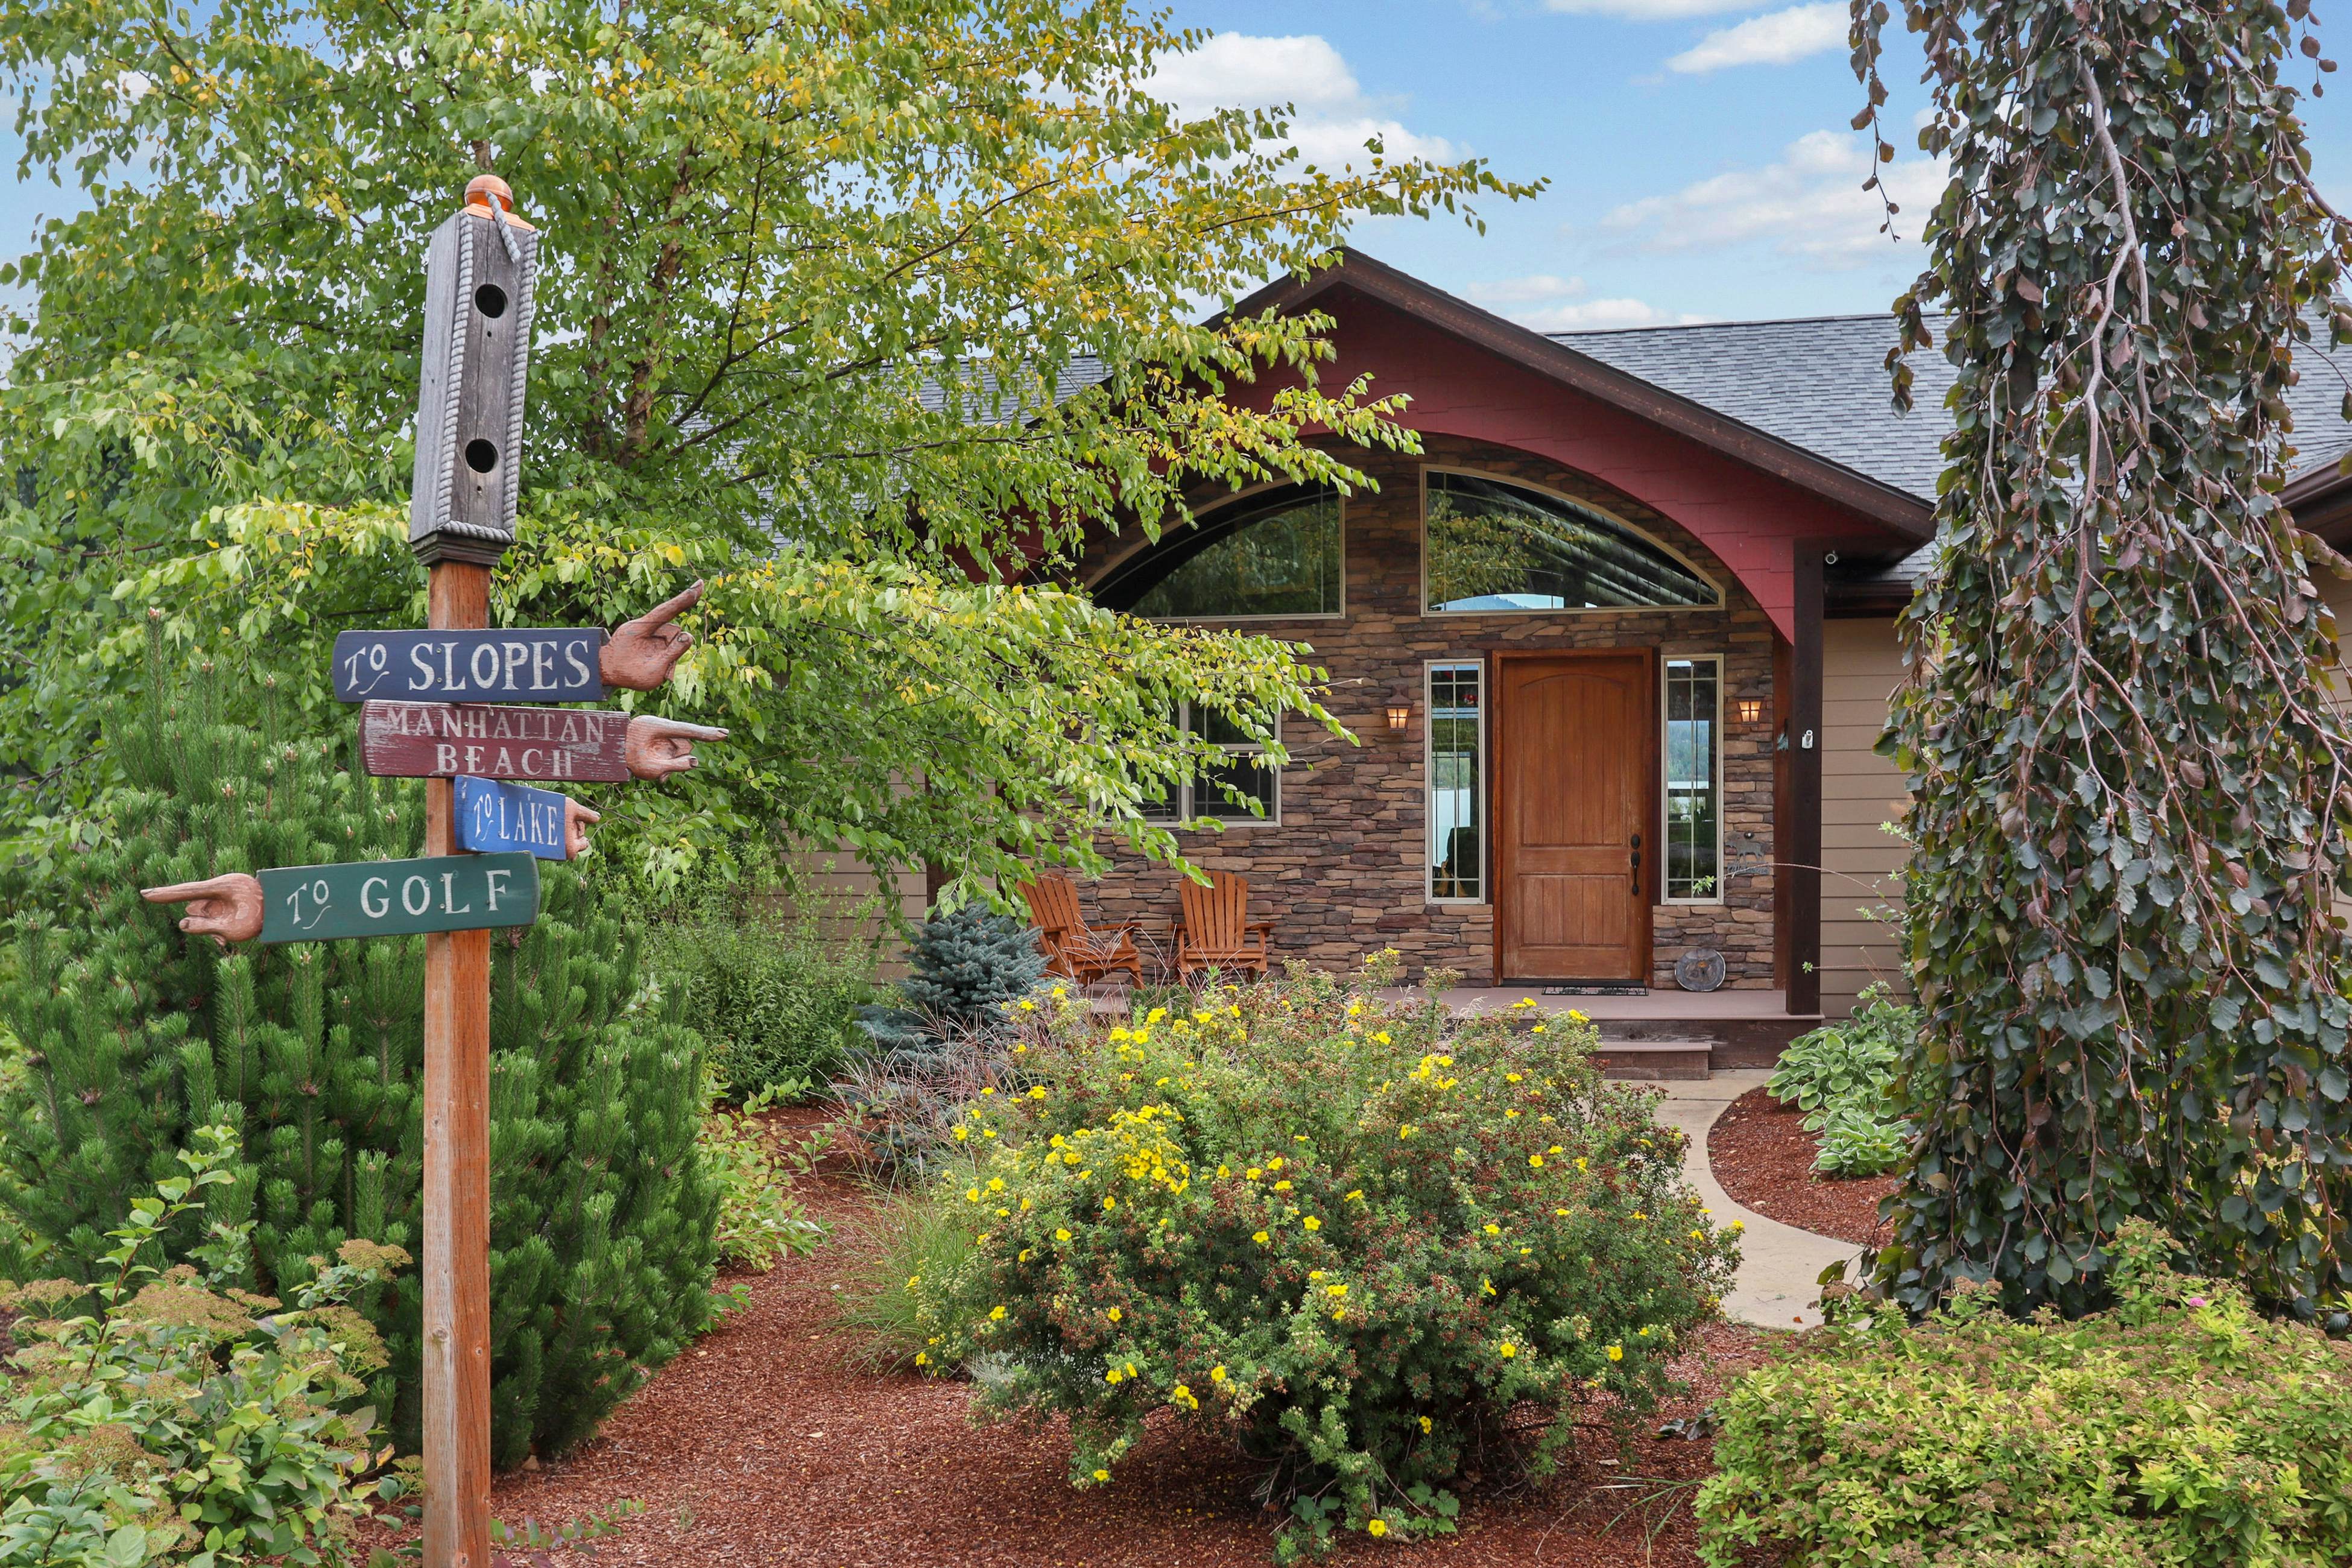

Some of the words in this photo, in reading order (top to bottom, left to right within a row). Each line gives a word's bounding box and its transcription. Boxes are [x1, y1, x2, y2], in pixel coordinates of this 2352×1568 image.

[409, 640, 590, 690] SLOPES
[387, 707, 605, 743] MANHATTAN
[434, 744, 573, 777] BEACH
[499, 797, 558, 846] LAKE
[361, 870, 511, 918] GOLF
